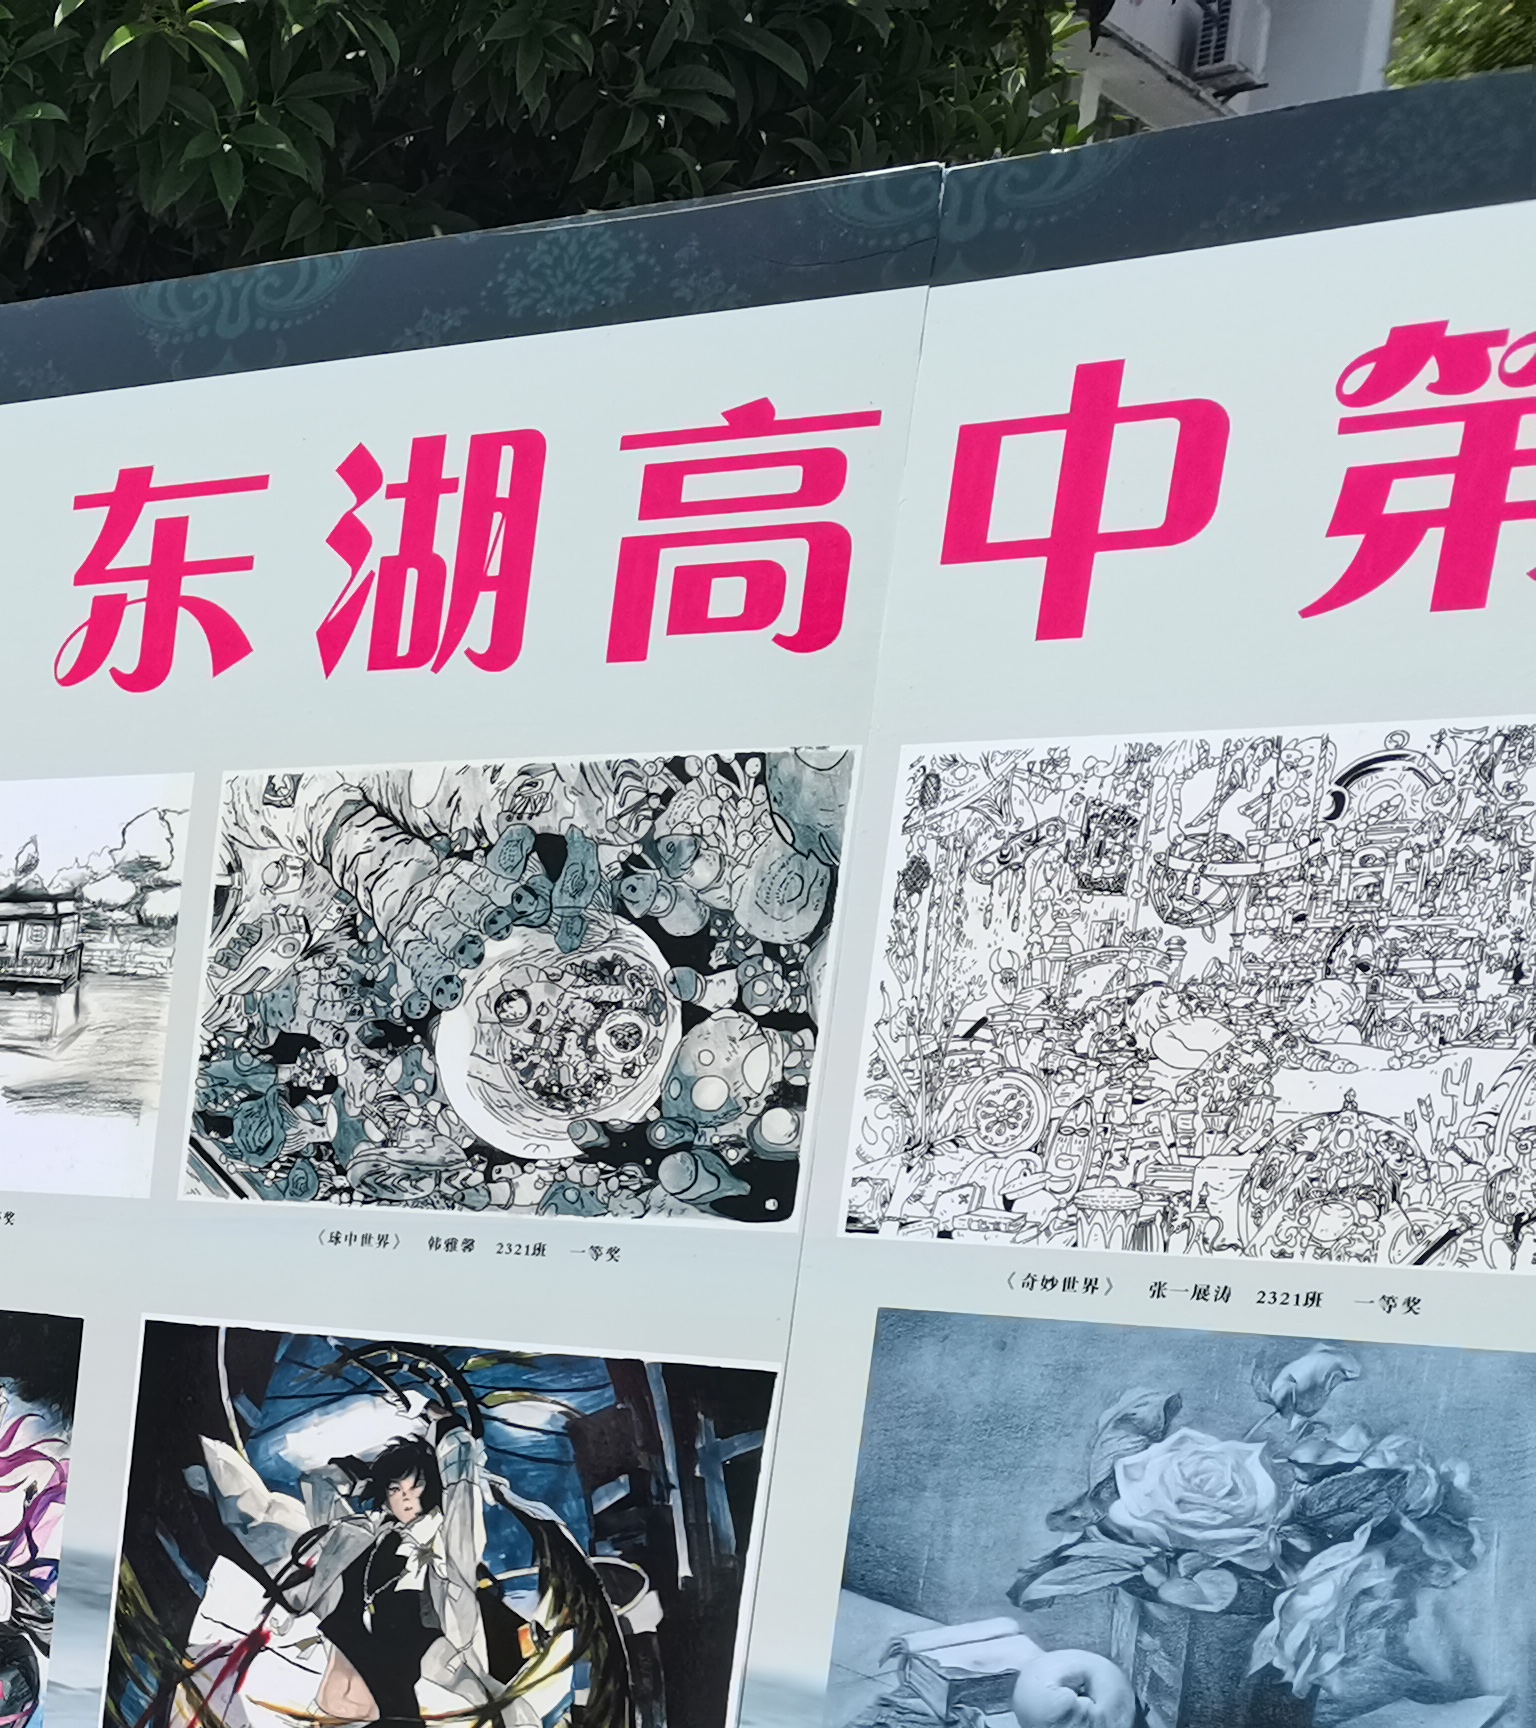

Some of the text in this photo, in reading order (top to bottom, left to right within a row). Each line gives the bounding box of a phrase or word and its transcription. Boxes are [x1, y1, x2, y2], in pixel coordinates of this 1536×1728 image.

[54, 319, 1536, 693] 东湖高中第
[317, 1228, 402, 1250] 《球中世界》
[495, 1242, 547, 1258] 2321班
[569, 1245, 621, 1263] 一等奖
[1005, 1270, 1115, 1297] 《奇妙世界》
[1256, 1289, 1324, 1309] 2321班
[1353, 1293, 1422, 1316] 一等奖
